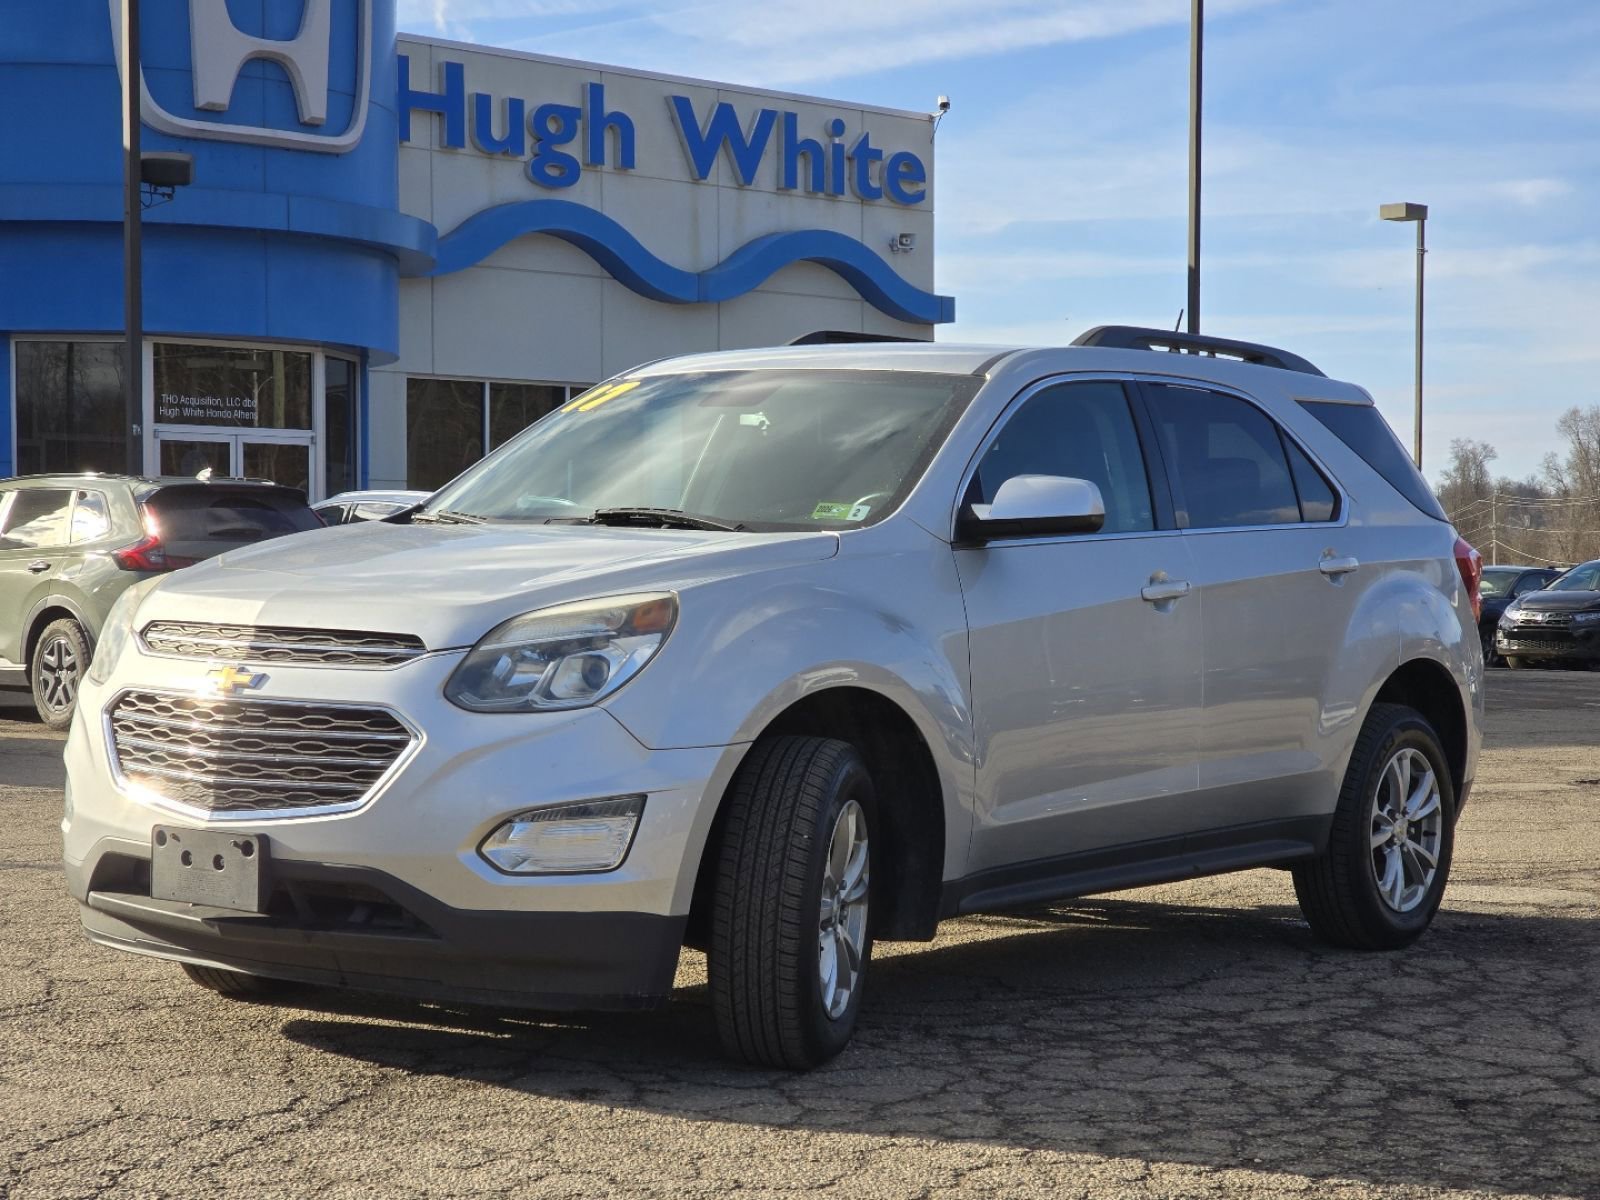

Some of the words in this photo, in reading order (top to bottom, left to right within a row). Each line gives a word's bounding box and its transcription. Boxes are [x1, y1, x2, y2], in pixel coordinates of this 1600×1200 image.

[397, 55, 636, 189] Hugh
[666, 95, 927, 206] White
[226, 397, 241, 407] LLC
[159, 405, 180, 419] Hugh
[182, 407, 204, 418] White
[206, 408, 231, 419] Honda
